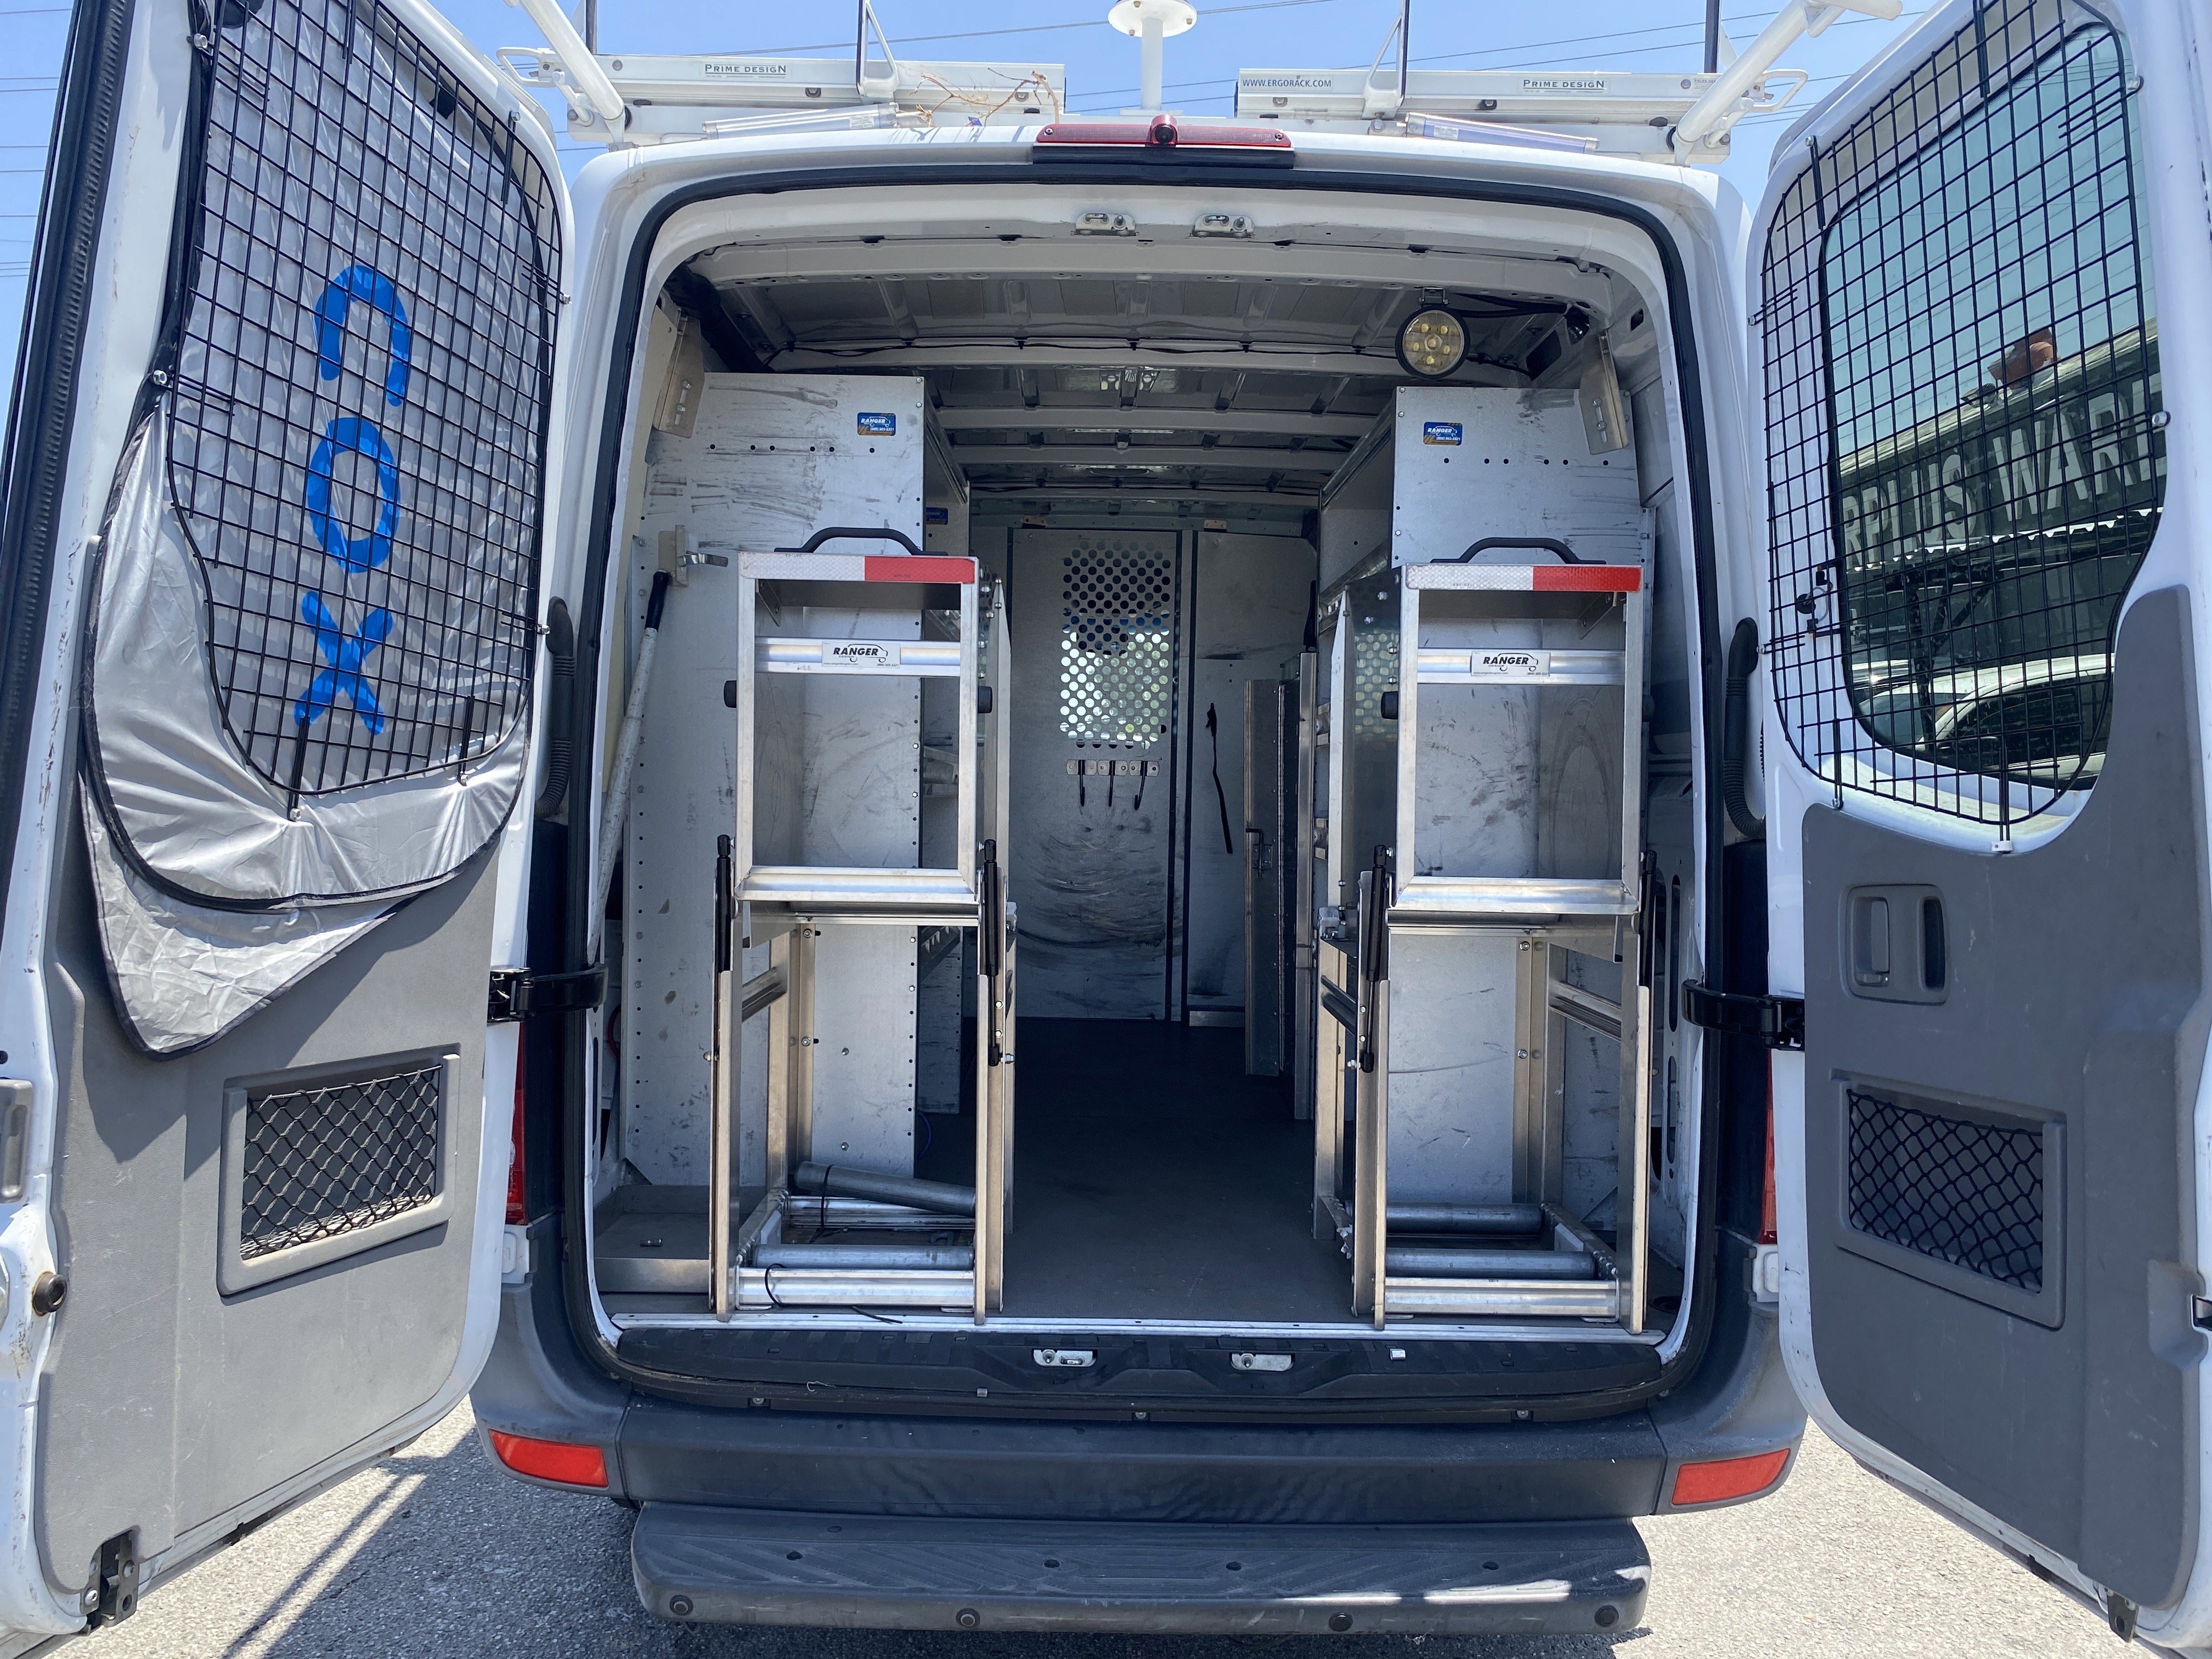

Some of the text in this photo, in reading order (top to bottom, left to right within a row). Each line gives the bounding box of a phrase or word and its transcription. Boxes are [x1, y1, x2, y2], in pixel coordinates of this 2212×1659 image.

[705, 64, 740, 72] PRIME
[1243, 78, 1331, 87] WWW.ERGORACK.COM
[294, 264, 411, 735] COX
[833, 647, 879, 656] RANGER
[1483, 656, 1529, 665] RANGER
